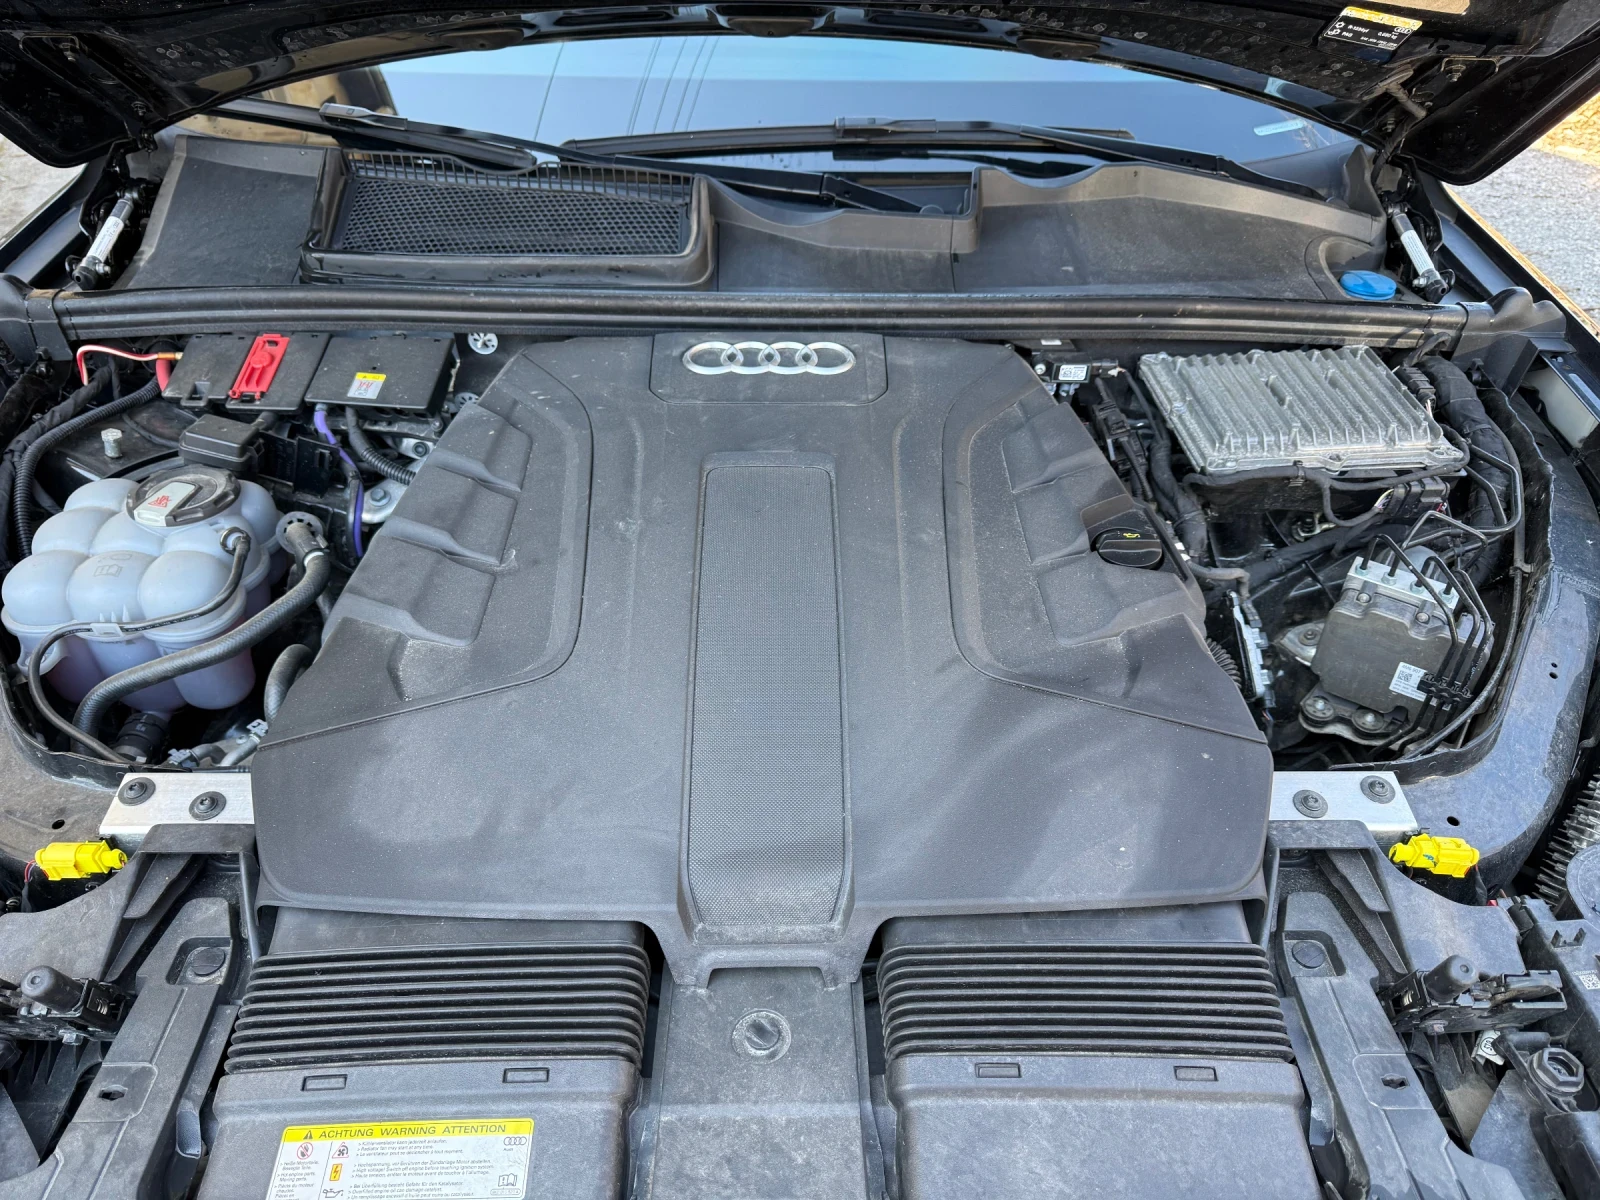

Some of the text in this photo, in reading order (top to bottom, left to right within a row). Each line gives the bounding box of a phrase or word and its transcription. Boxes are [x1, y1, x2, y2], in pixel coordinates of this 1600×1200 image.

[319, 1124, 506, 1139] ACHTUNG WARNING ATTENTION
